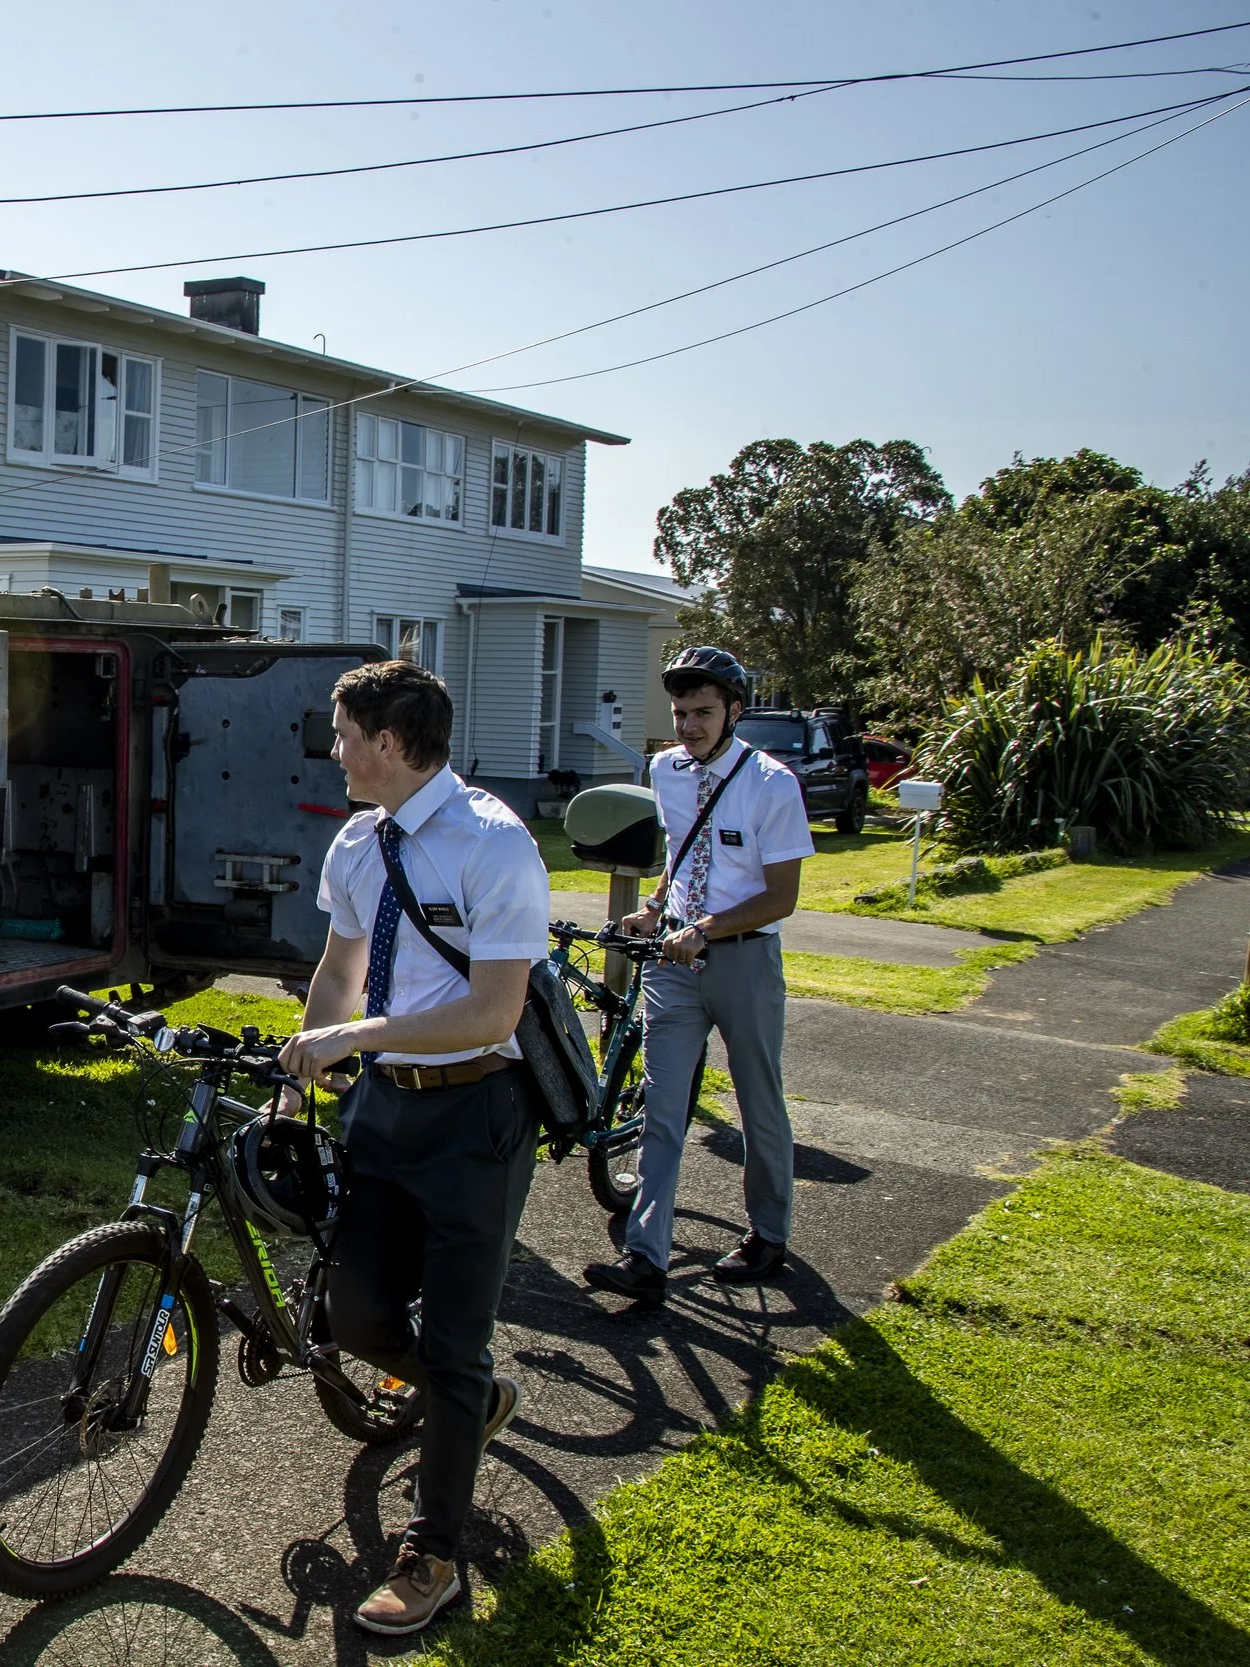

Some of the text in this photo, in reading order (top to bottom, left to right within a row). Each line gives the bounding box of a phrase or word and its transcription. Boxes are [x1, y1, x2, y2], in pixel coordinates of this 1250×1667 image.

[245, 1219, 286, 1308] ERIDA
[142, 1311, 170, 1376] SR SUNTOUR
